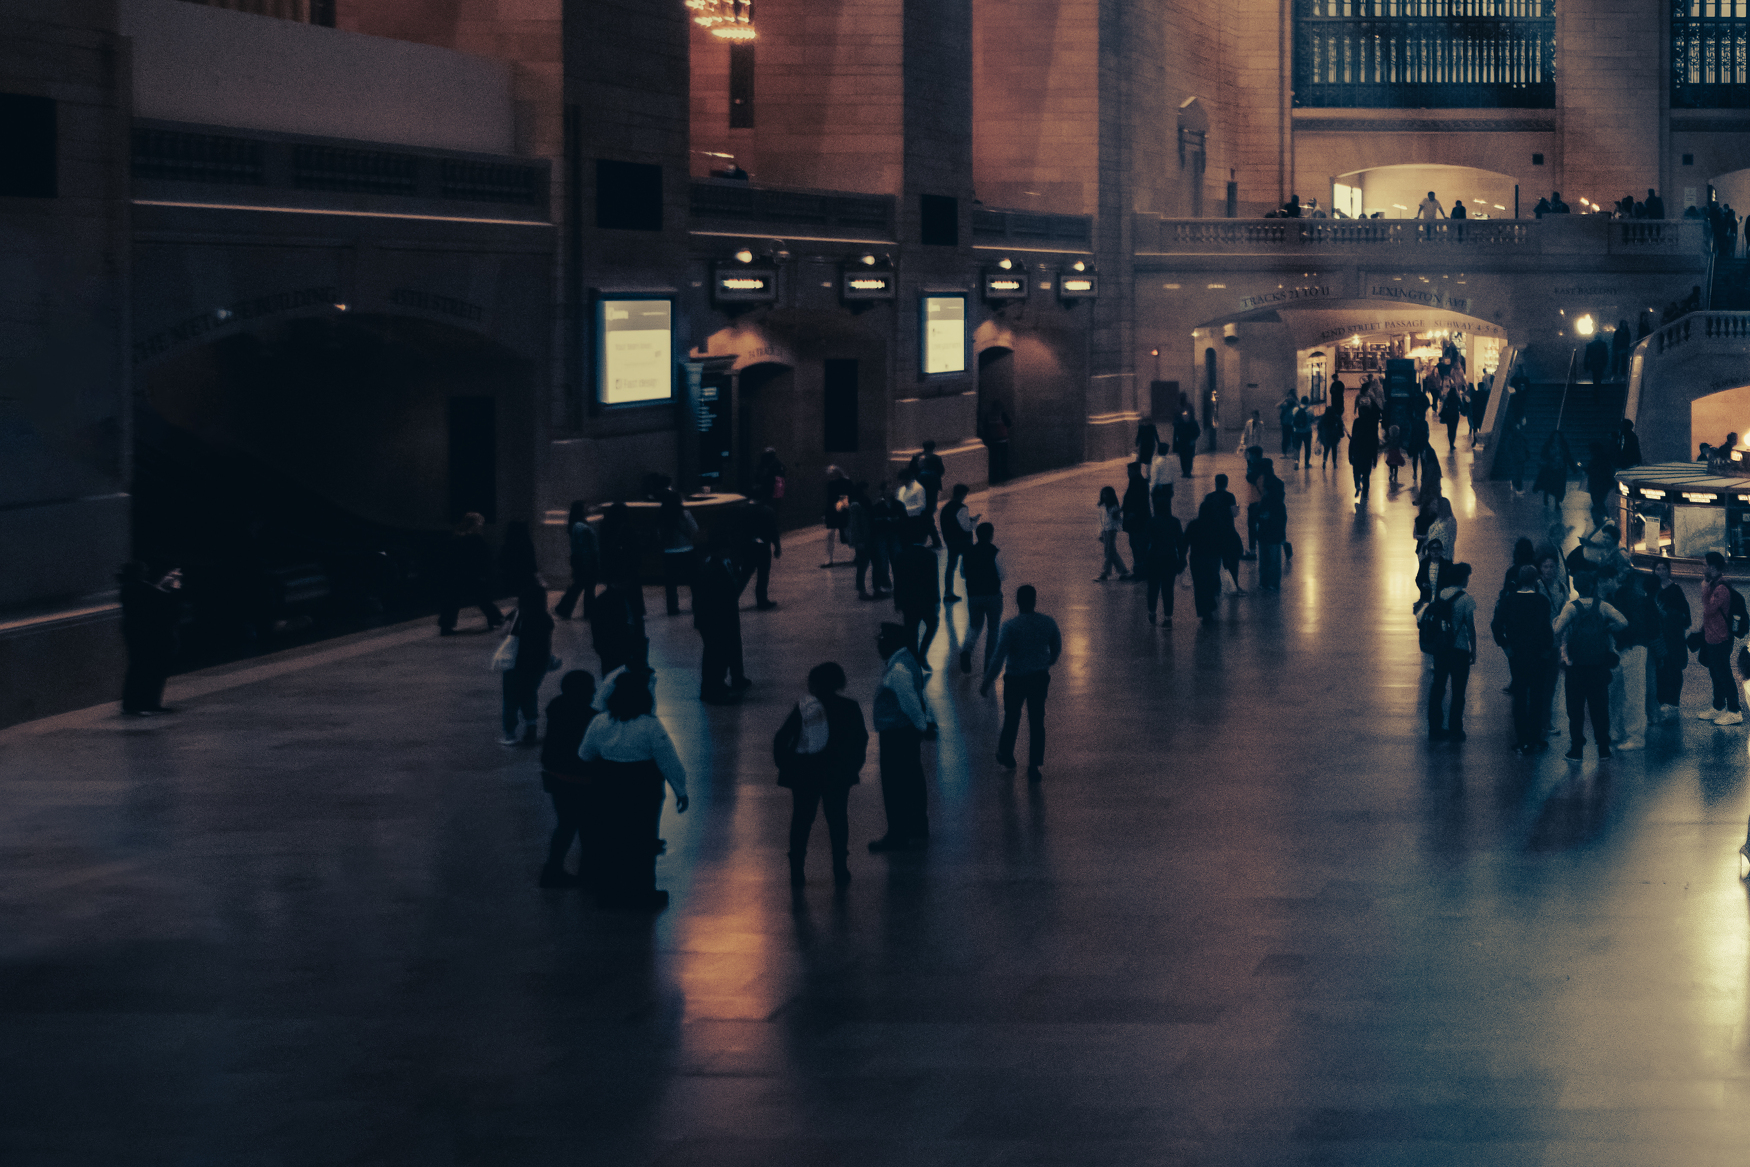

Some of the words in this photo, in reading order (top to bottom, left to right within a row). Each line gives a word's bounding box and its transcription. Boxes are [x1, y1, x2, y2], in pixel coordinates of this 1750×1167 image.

[256, 286, 337, 317] BUILDING
[432, 294, 482, 321] STREET
[1241, 290, 1287, 308] TRACKS
[1302, 288, 1319, 297] TO
[1372, 286, 1441, 304] LEXINGTON
[1445, 296, 1466, 308] AVE
[1347, 322, 1381, 332] STREET
[1384, 319, 1425, 329] PASSAGE
[1434, 321, 1472, 331] SUBWAY
